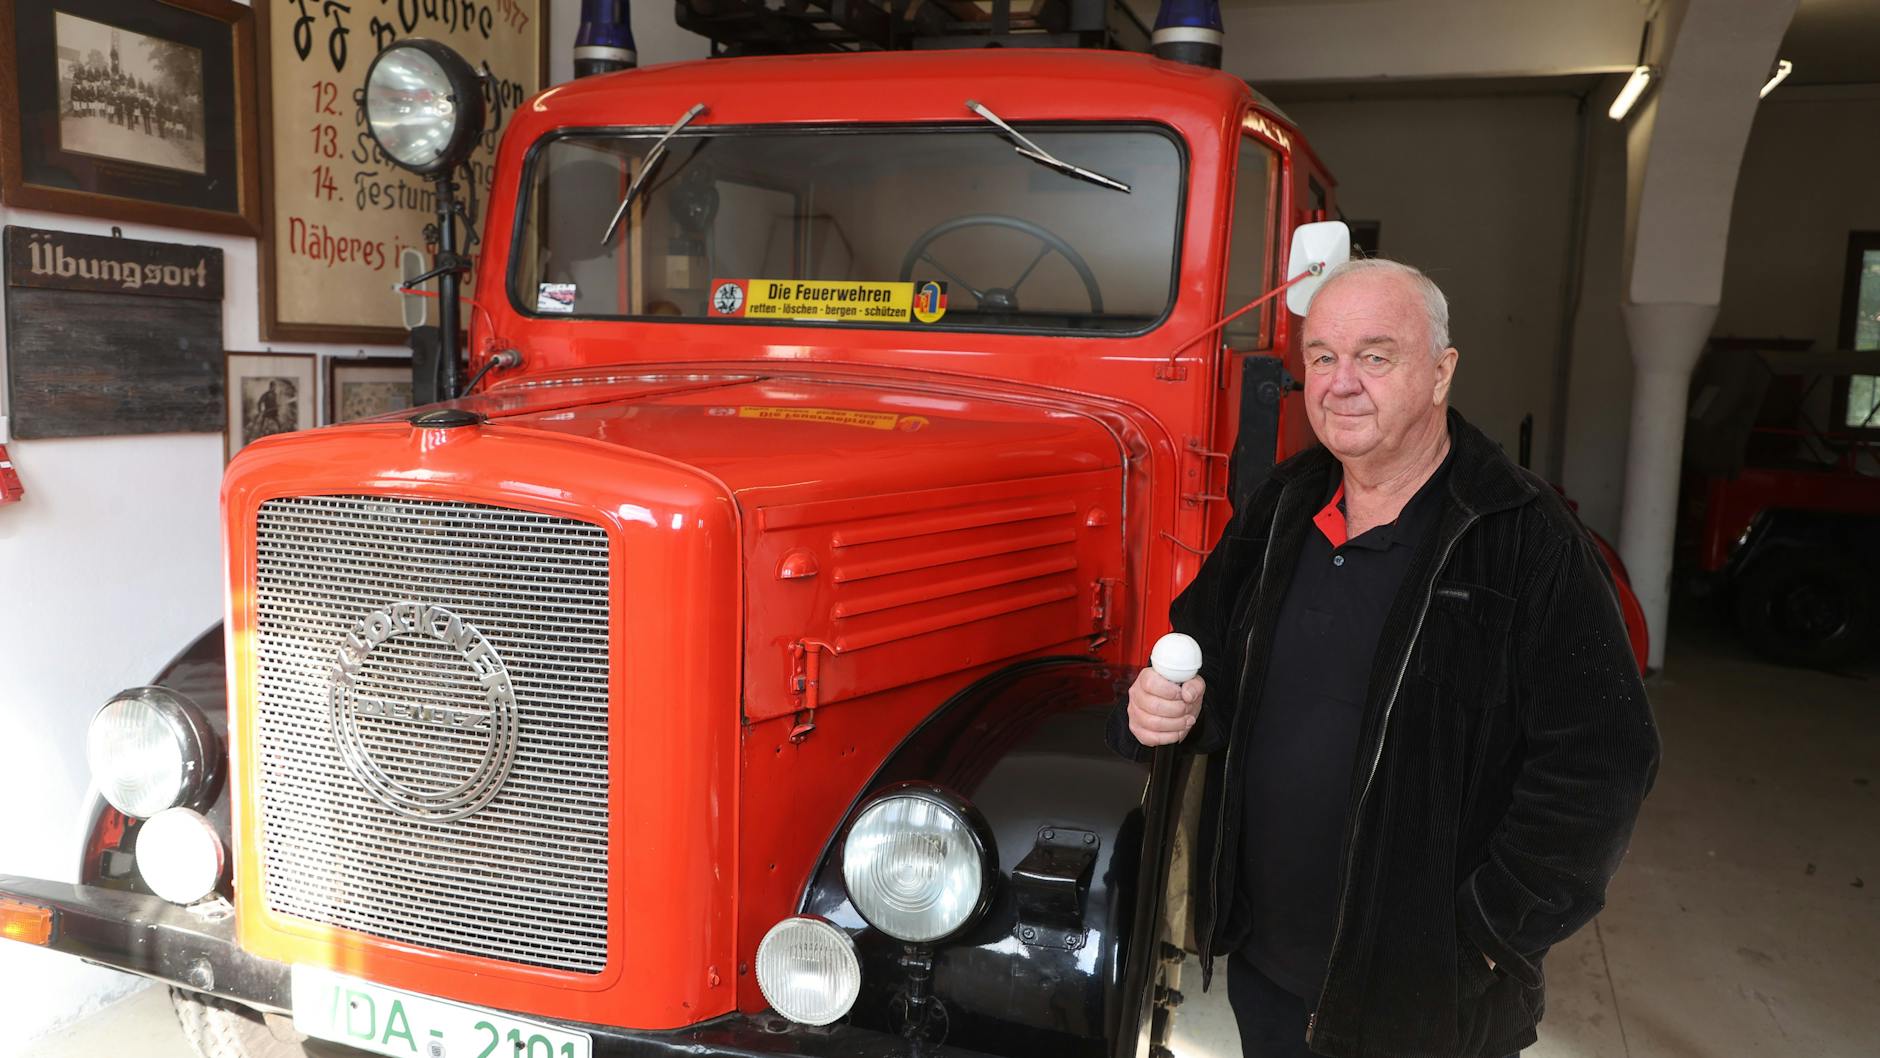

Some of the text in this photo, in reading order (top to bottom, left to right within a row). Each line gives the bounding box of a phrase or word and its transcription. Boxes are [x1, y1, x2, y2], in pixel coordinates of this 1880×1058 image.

[311, 80, 343, 117] 12.
[311, 123, 344, 160] 13.
[312, 165, 344, 202] 14.
[28, 233, 207, 288] Übungsort
[289, 216, 385, 271] Näheres
[749, 303, 776, 314] retten
[783, 303, 818, 315] löschen
[825, 304, 857, 318] bergen
[864, 306, 907, 318] schützen
[768, 283, 892, 303] Die Feuerwehren
